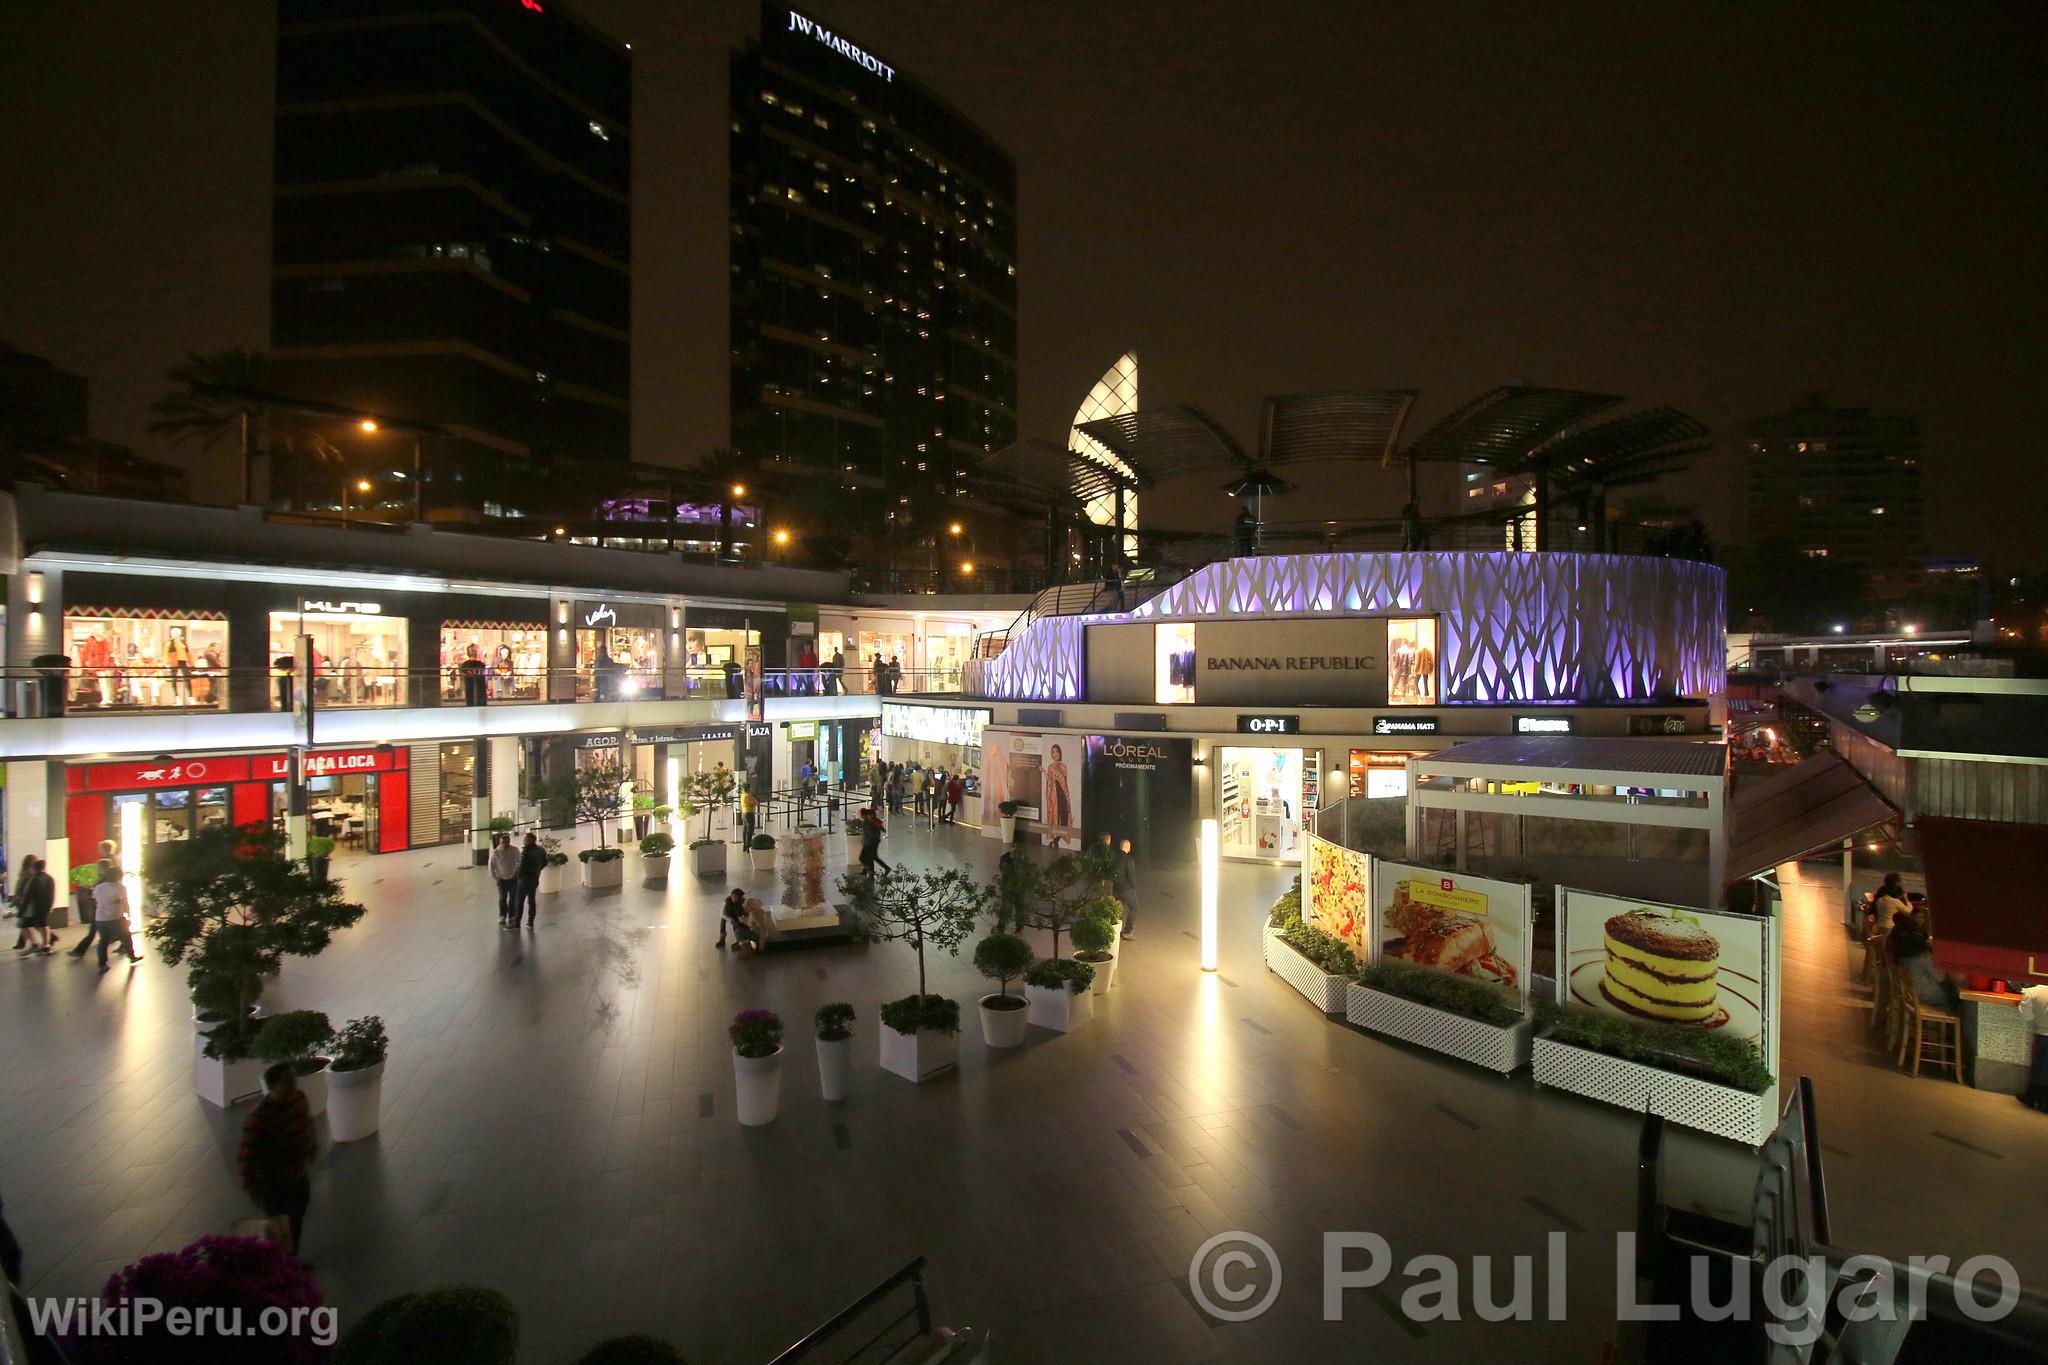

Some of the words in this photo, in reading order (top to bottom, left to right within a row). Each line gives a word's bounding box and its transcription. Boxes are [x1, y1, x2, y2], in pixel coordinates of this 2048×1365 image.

[788, 10, 814, 35] JW
[815, 24, 895, 83] MARRIOTT
[1207, 656, 1281, 671] BANANA
[1286, 656, 1377, 671] REPUBLIC
[1386, 722, 1416, 730] PANAMA
[1416, 722, 1435, 730] HATS
[272, 760, 291, 773] LA
[338, 754, 376, 769] LOCA
